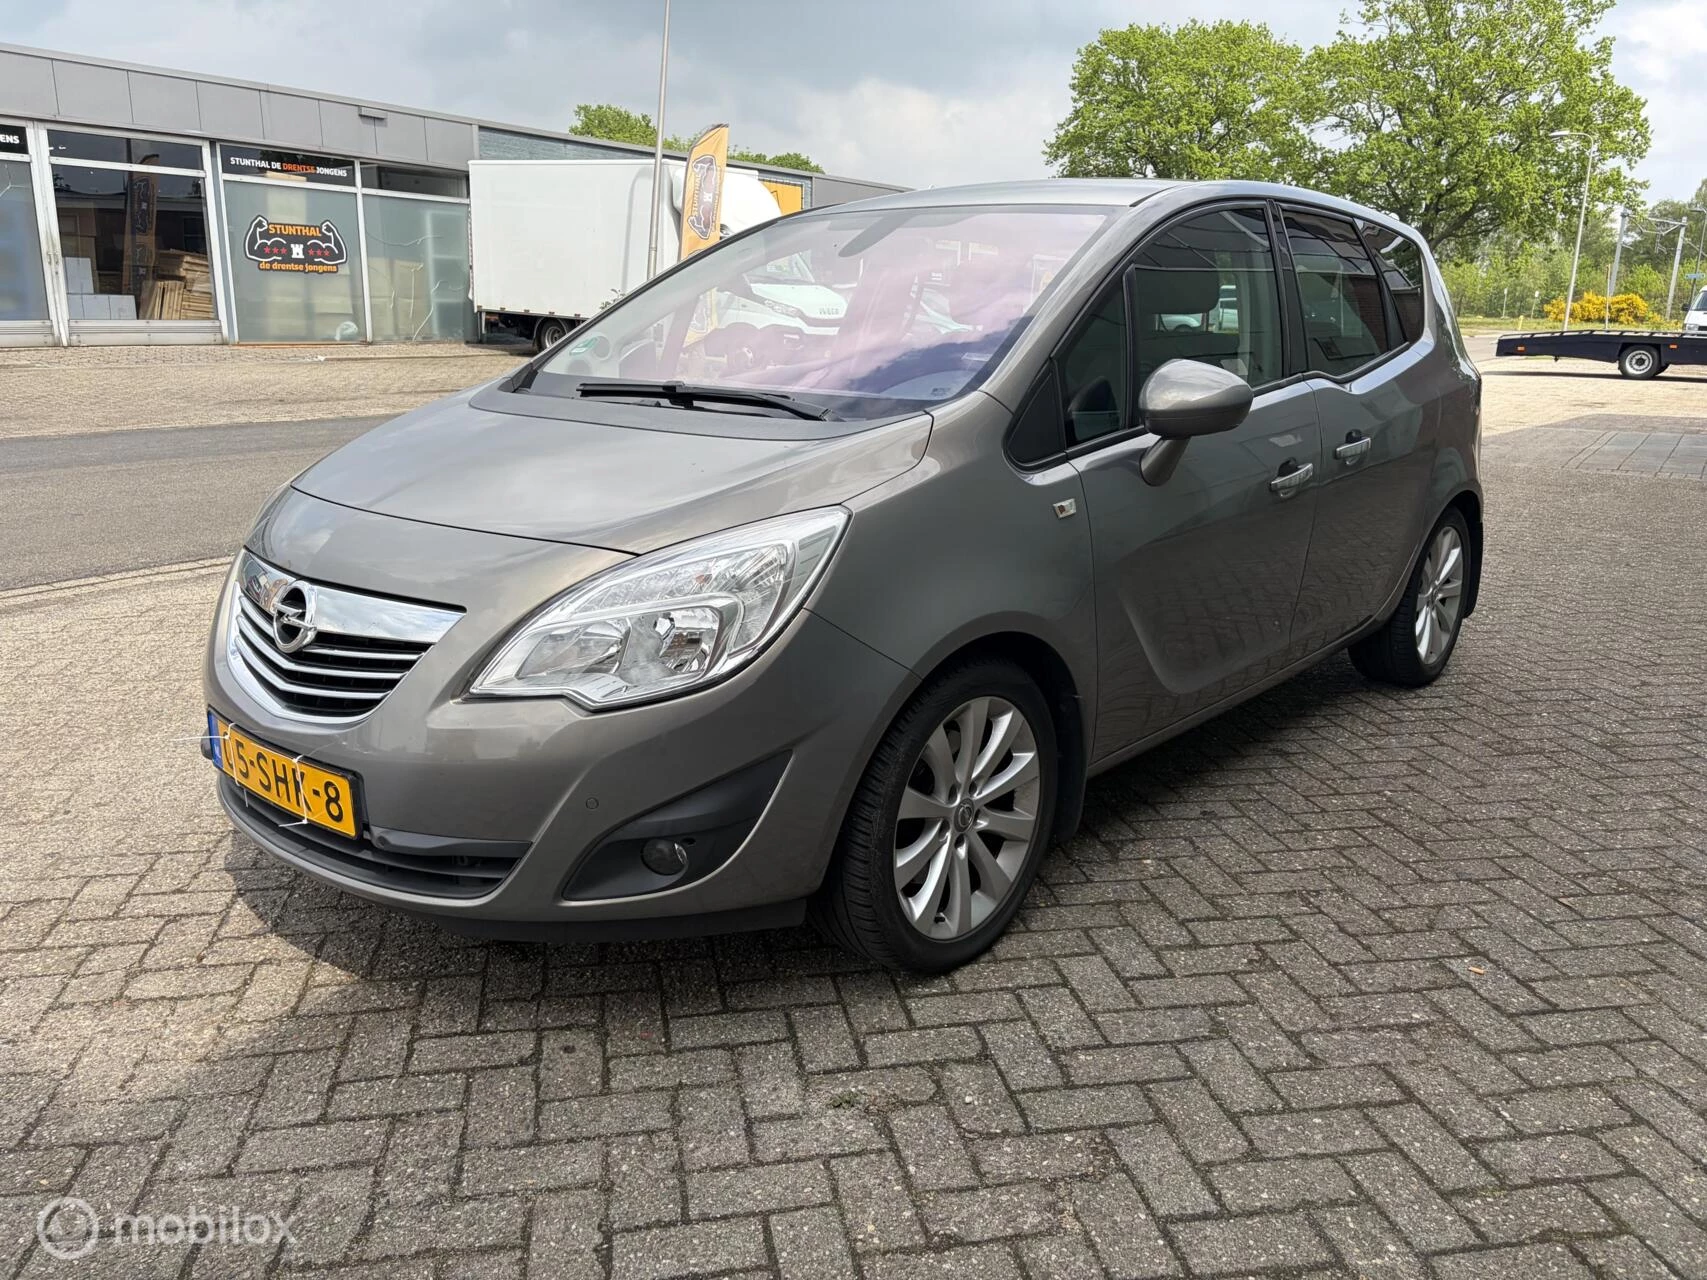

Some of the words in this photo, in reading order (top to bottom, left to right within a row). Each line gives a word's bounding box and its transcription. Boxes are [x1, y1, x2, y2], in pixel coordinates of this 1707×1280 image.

[230, 157, 270, 168] STUNTHAL
[271, 161, 281, 170] DE
[282, 163, 316, 174] DRENTSE
[316, 166, 347, 177] JONGENS
[268, 224, 322, 237] STUNTHAL
[259, 261, 270, 270] de
[271, 262, 304, 271] drentse
[305, 263, 337, 273] jongens
